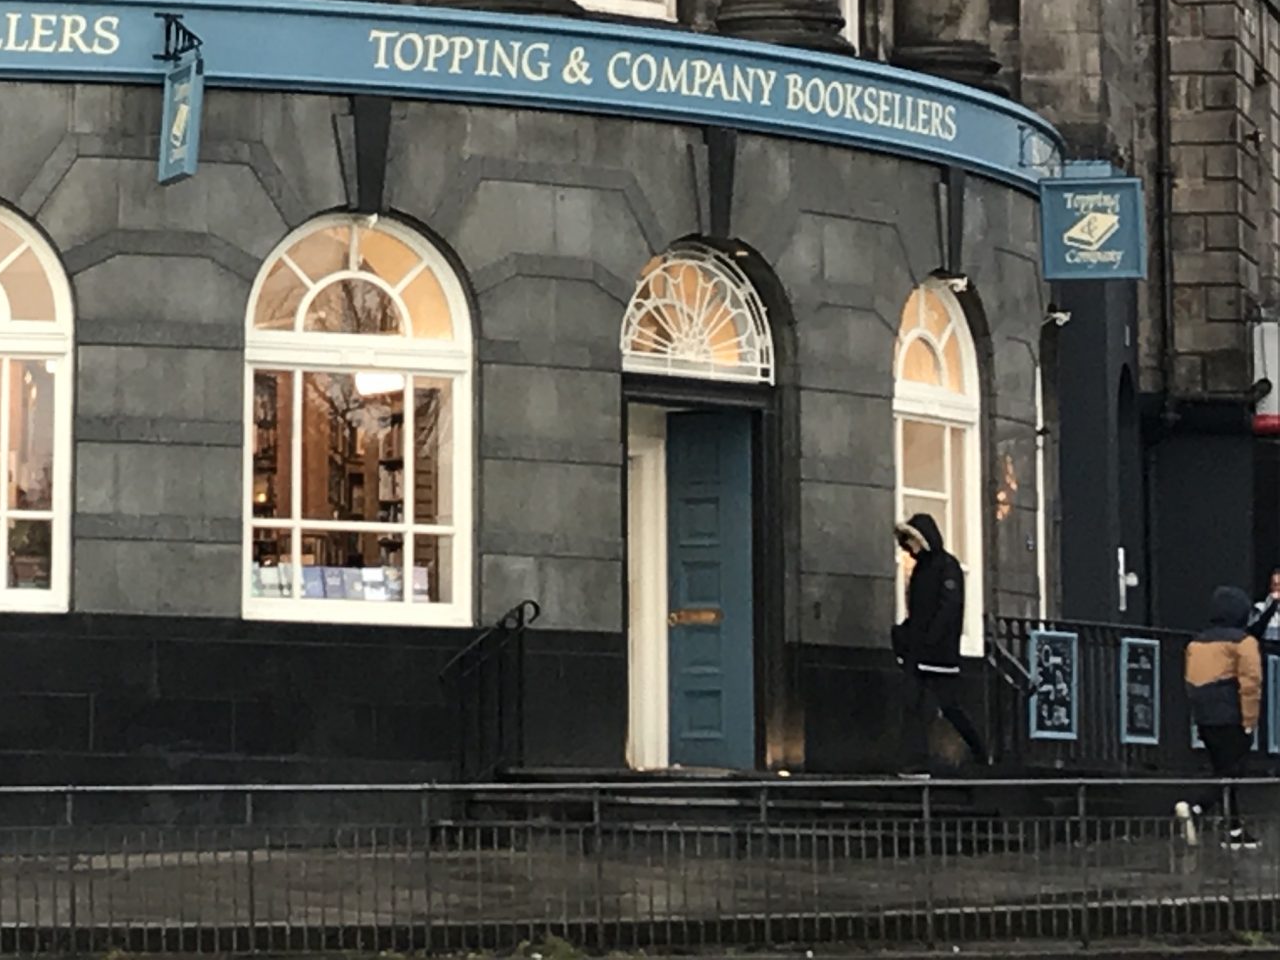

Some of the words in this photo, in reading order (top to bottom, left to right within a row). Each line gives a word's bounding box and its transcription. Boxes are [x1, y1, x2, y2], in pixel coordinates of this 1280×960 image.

[368, 29, 551, 82] TOPPING
[562, 46, 593, 86] &
[607, 51, 777, 107] COMPANY
[785, 72, 958, 142] BOOKSELLERS
[1062, 190, 1121, 216] Topping
